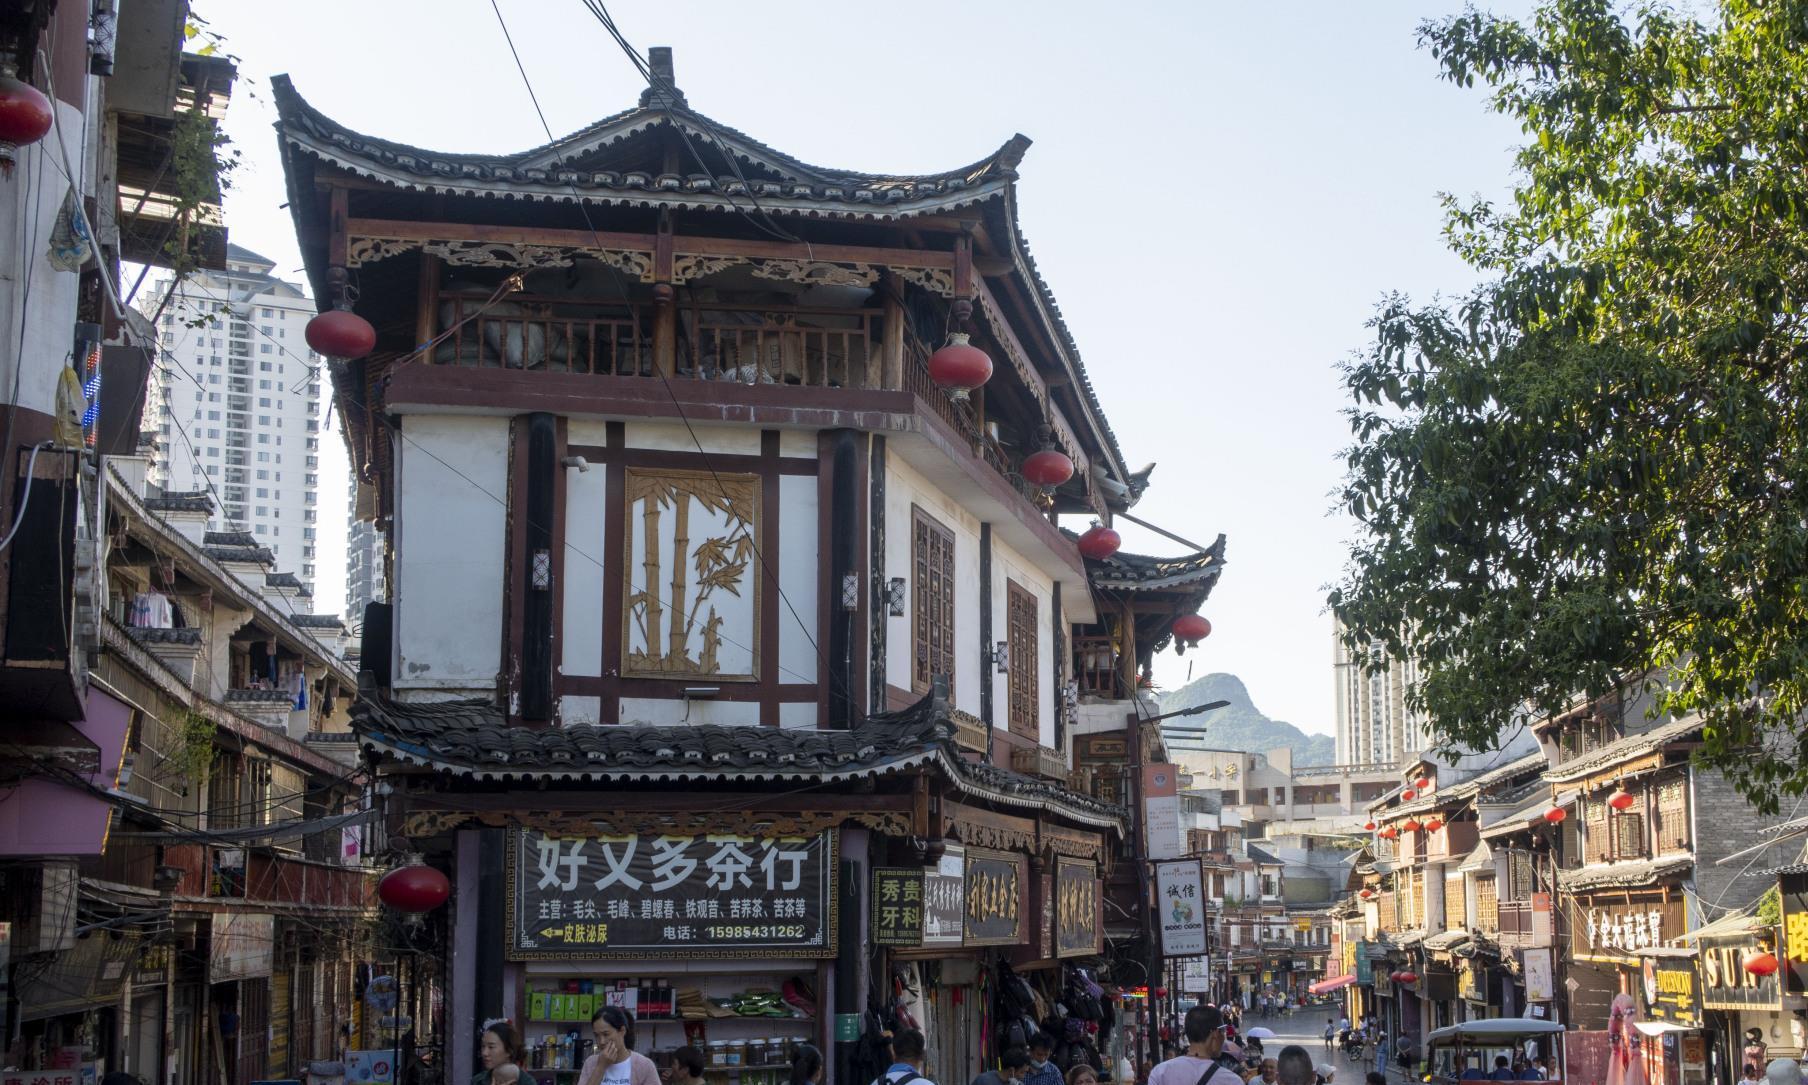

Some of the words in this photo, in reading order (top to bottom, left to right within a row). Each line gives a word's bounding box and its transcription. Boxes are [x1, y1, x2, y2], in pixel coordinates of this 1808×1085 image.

[536, 831, 809, 892] 好又多茶行
[1167, 884, 1195, 899] 诚信
[881, 907, 921, 928] 牙科
[563, 922, 608, 944] 皮肤泌尿
